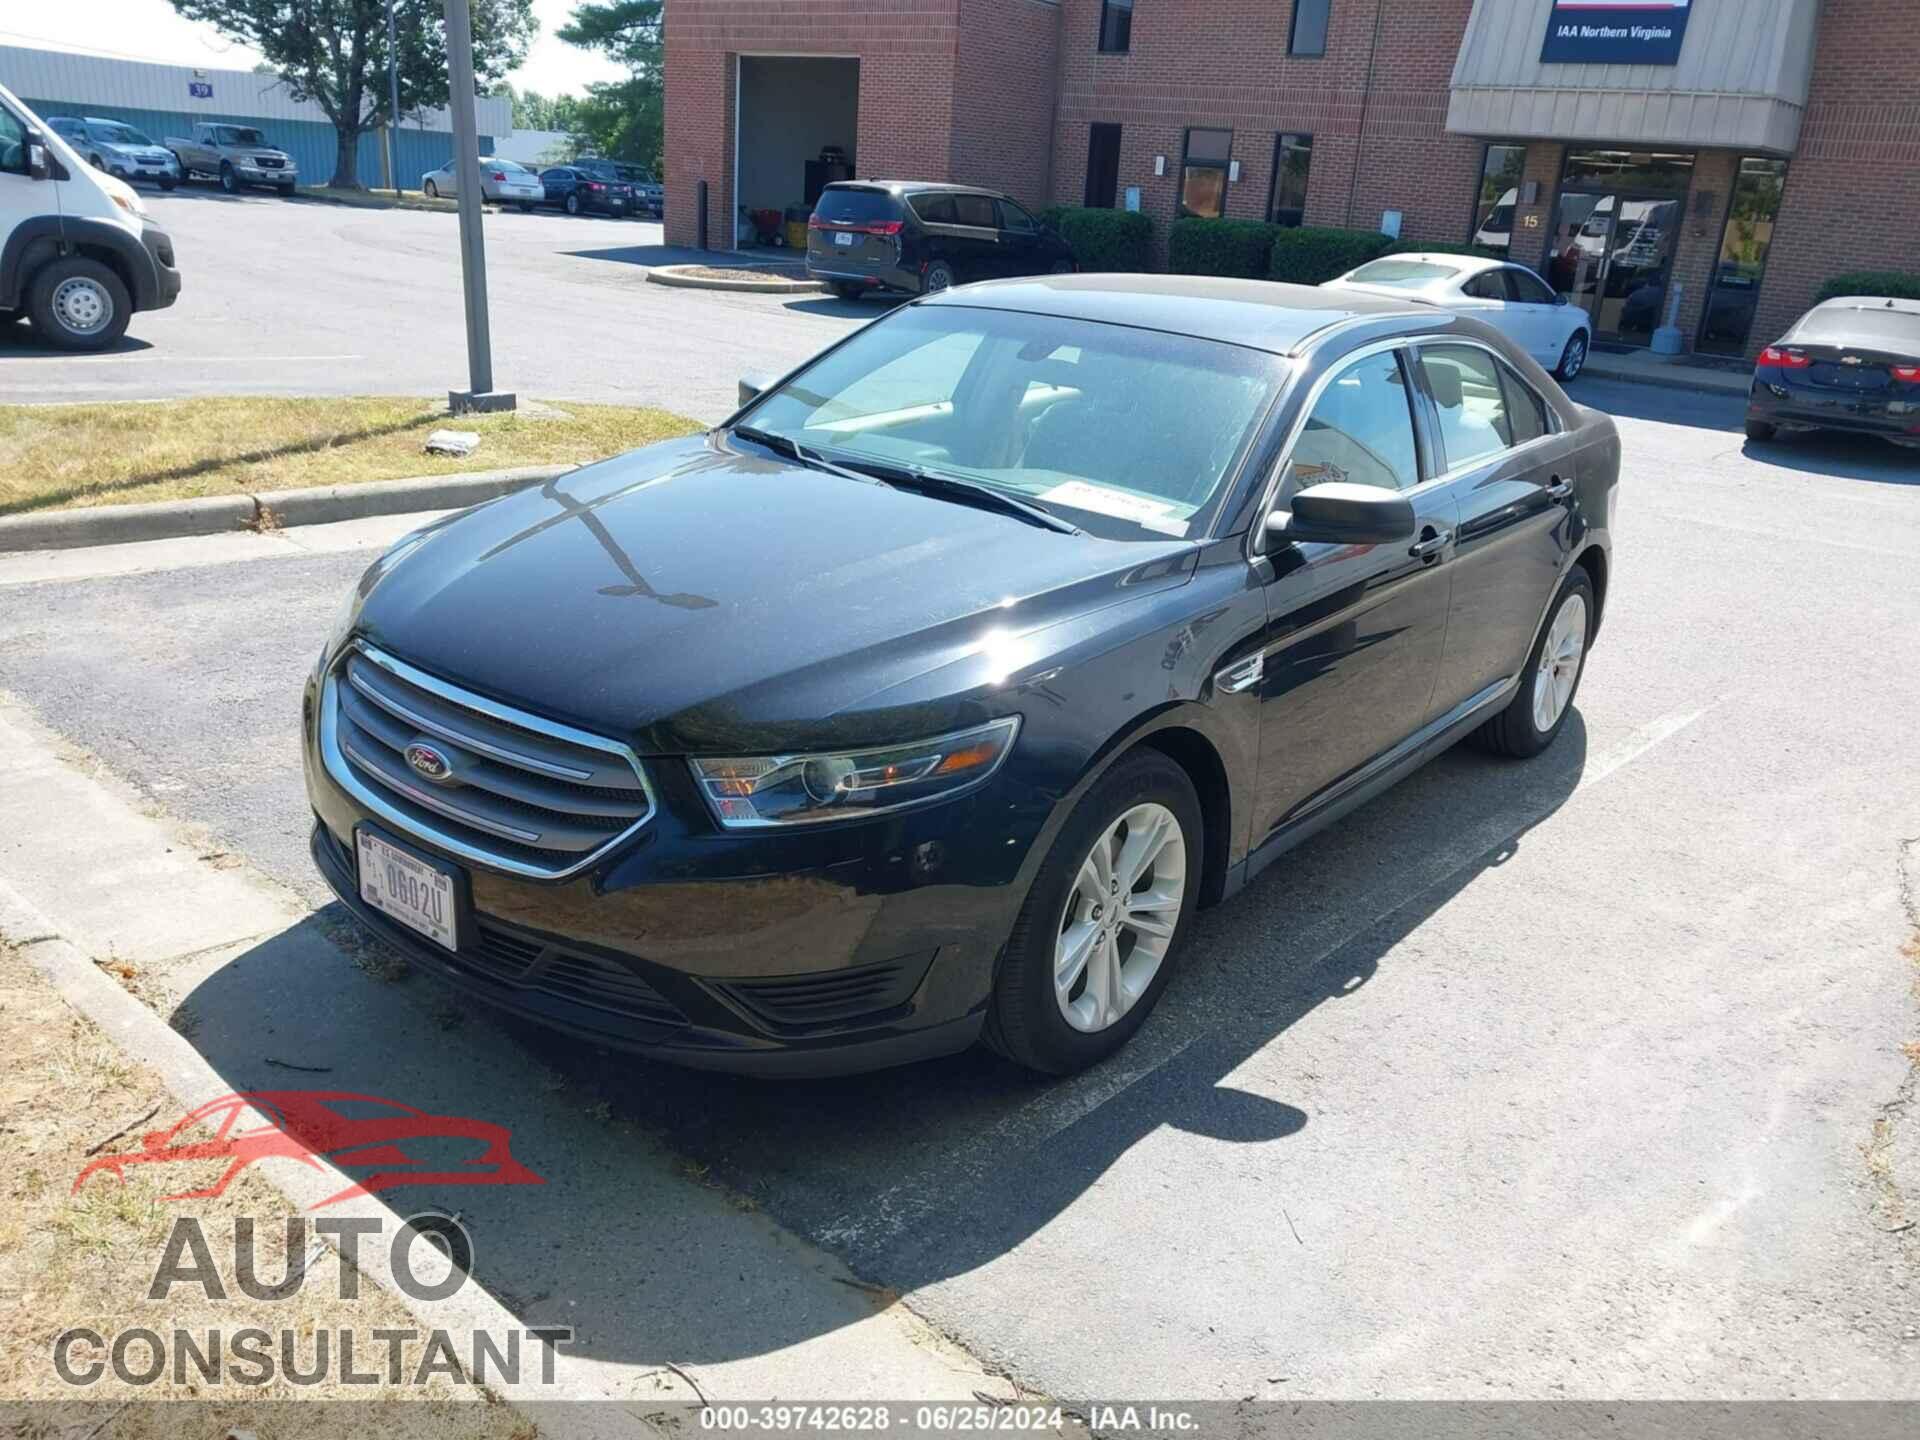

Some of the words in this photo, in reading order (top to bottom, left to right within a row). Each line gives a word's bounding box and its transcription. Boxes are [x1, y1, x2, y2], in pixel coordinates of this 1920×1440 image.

[1557, 25, 1578, 38] IAA
[1580, 25, 1628, 38] Northern
[1630, 26, 1671, 40] Virginia
[1524, 215, 1538, 228] 15
